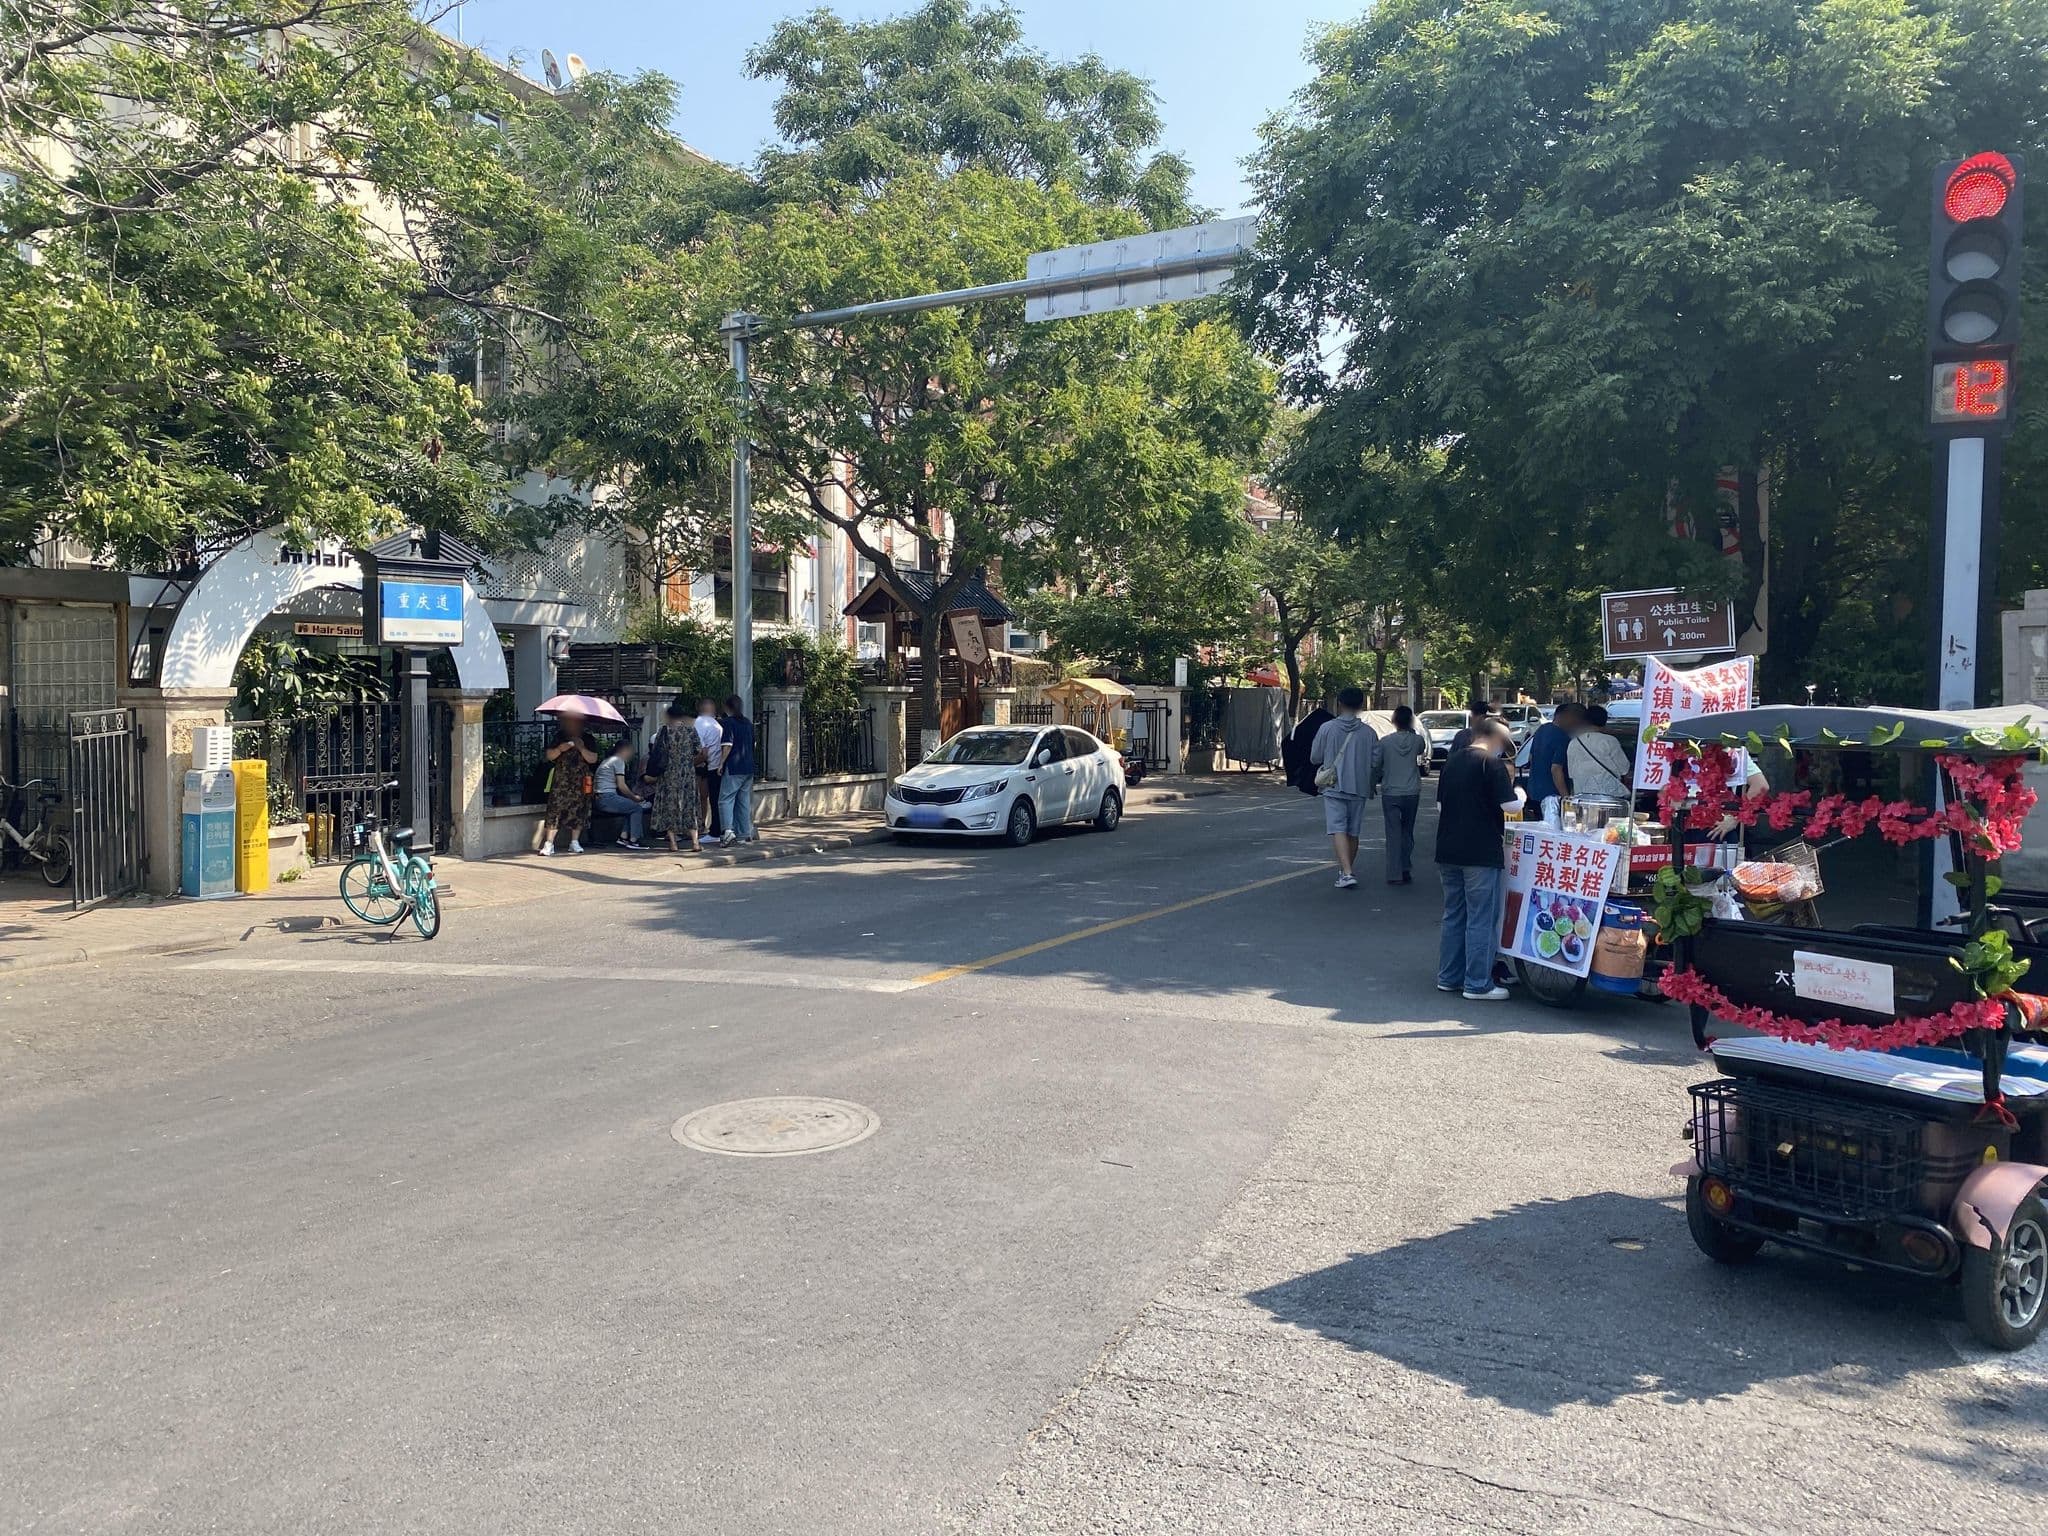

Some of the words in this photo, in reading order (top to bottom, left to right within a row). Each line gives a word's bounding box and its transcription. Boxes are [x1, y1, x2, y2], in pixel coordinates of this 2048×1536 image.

[1956, 361, 2005, 416] 12
[307, 549, 353, 568] Hair
[397, 592, 449, 611] 重庆道
[313, 625, 333, 634] Hair
[1658, 617, 1684, 626] Public
[1685, 616, 1710, 624] Toilet
[1680, 632, 1705, 640] 300m
[1510, 837, 1522, 877] 老味道
[1538, 840, 1609, 870] 天津名吃
[1534, 861, 1604, 897] 熟梨糕
[1774, 970, 1796, 987] 大
